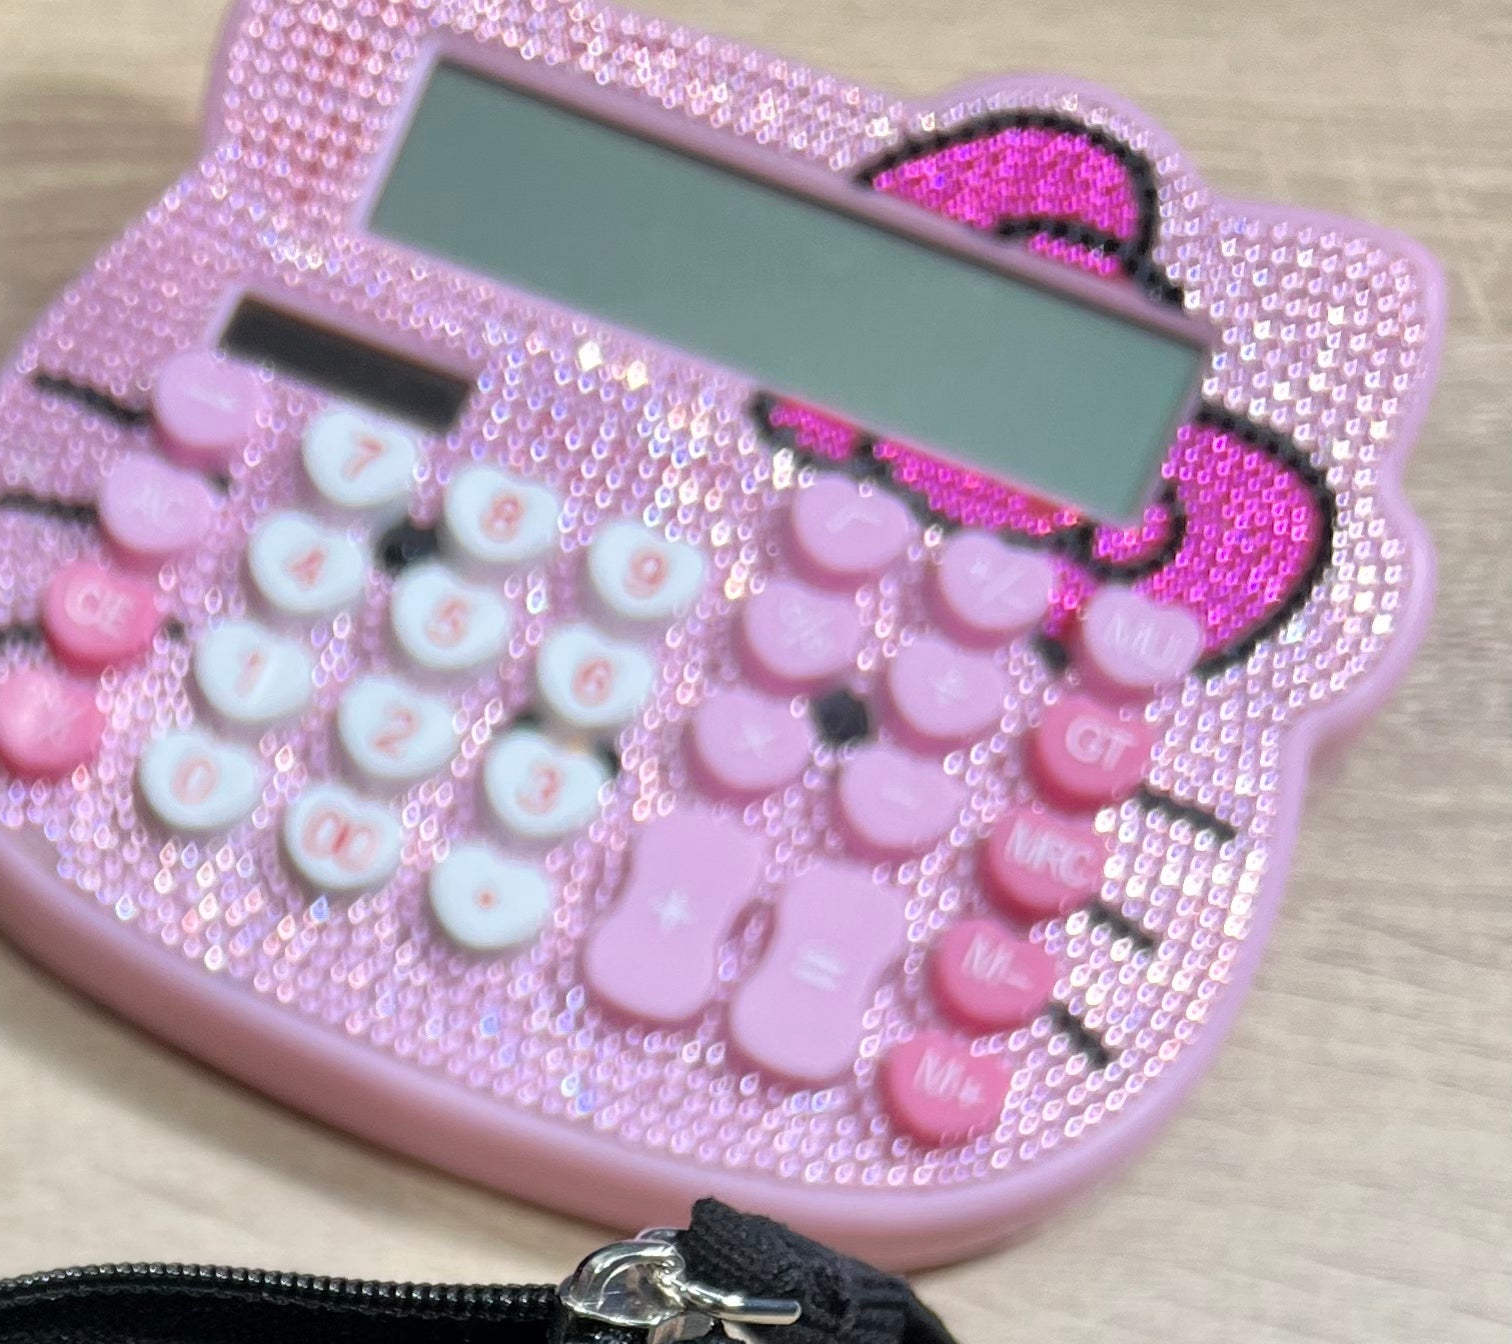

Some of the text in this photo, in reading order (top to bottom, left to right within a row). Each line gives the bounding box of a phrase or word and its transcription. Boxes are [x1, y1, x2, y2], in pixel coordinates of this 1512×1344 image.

[341, 435, 671, 600] 7 8 9
[286, 547, 333, 590] 4
[425, 595, 471, 650] 5
[375, 703, 424, 755] 2
[1065, 714, 1136, 773] GT
[1004, 817, 1097, 889] MRC
